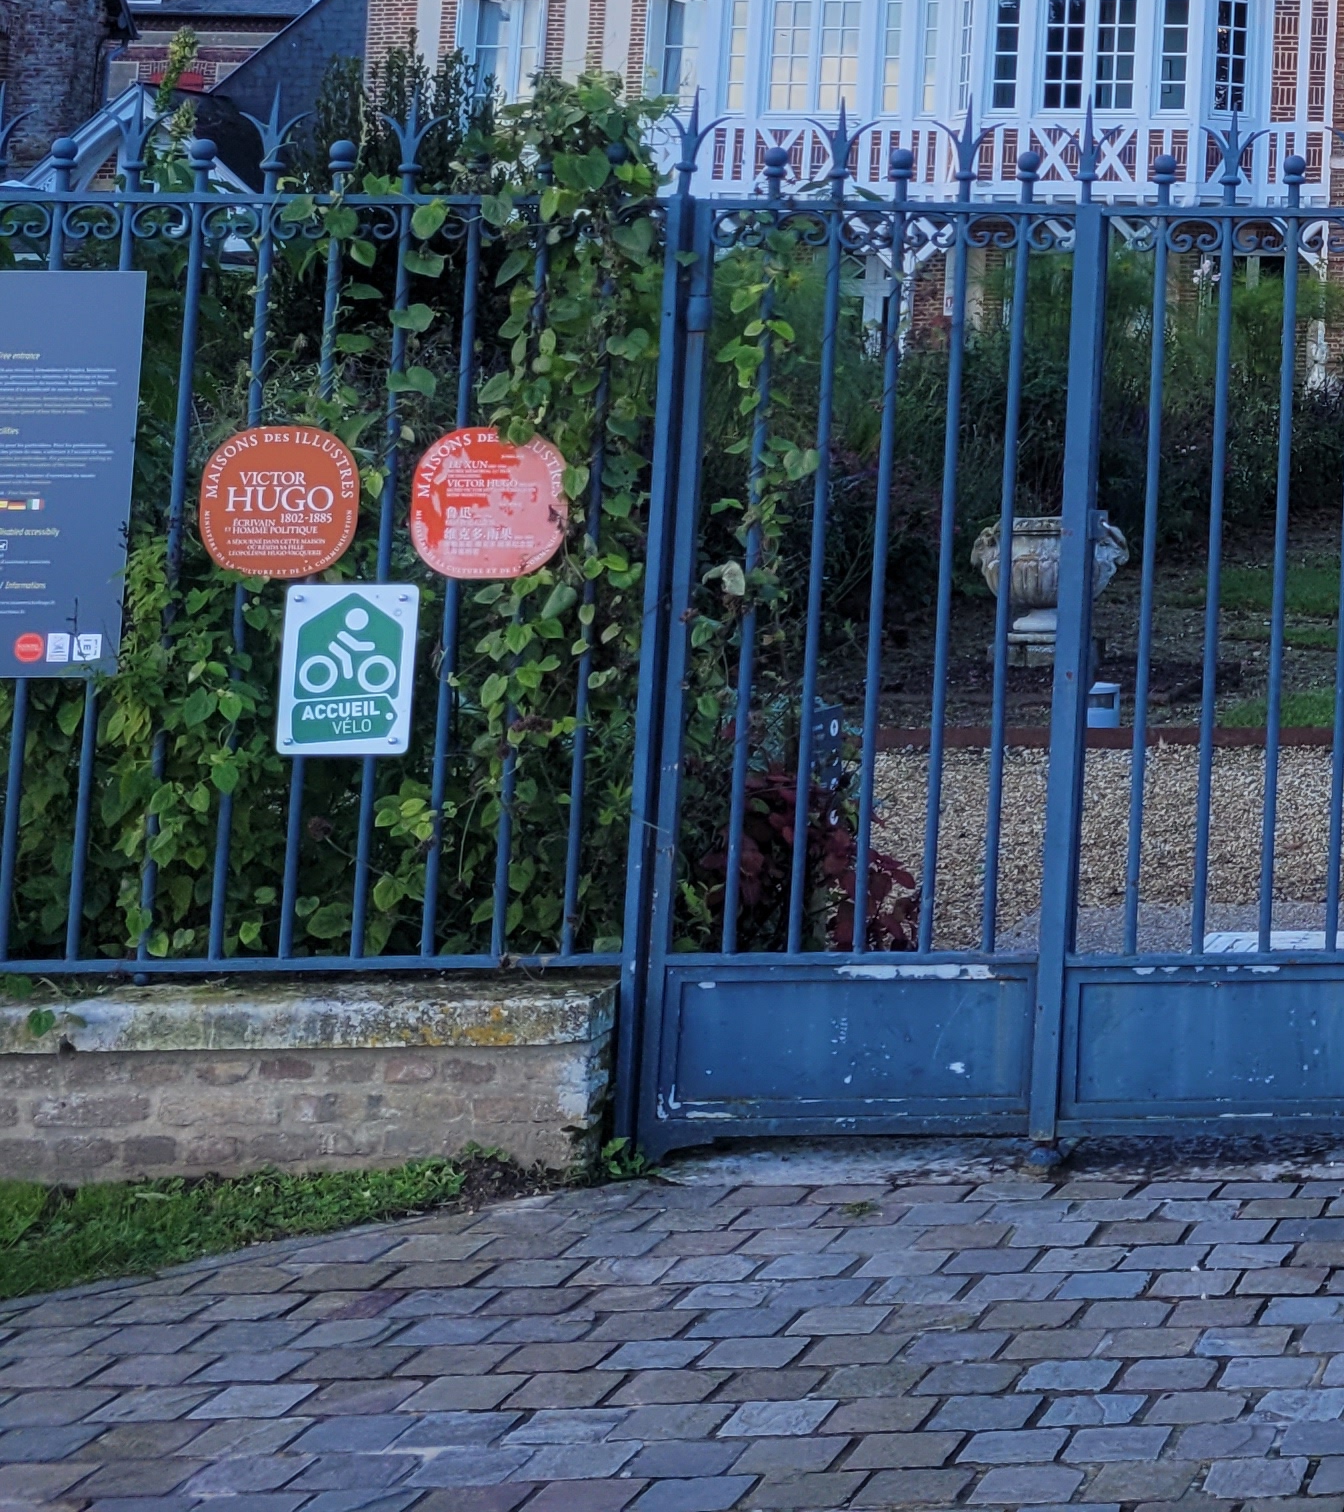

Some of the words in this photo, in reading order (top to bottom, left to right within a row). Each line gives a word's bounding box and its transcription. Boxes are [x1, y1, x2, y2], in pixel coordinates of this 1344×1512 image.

[205, 434, 258, 499] MAISONS
[264, 433, 290, 443] DES
[295, 431, 354, 499] ILLUSTRES
[417, 433, 472, 498] MAISONS
[239, 471, 307, 486] VICTOR
[447, 478, 486, 488] VICTOR
[486, 478, 518, 488] HUGO
[225, 485, 334, 512] HUGO
[233, 517, 276, 527] ÉCRIVAIN
[280, 513, 333, 524] 1802-1885
[232, 526, 268, 535] HOMME
[269, 525, 318, 536] POLITIQUE
[301, 700, 381, 721] ACCUEIL
[332, 717, 372, 735] VÉLO
